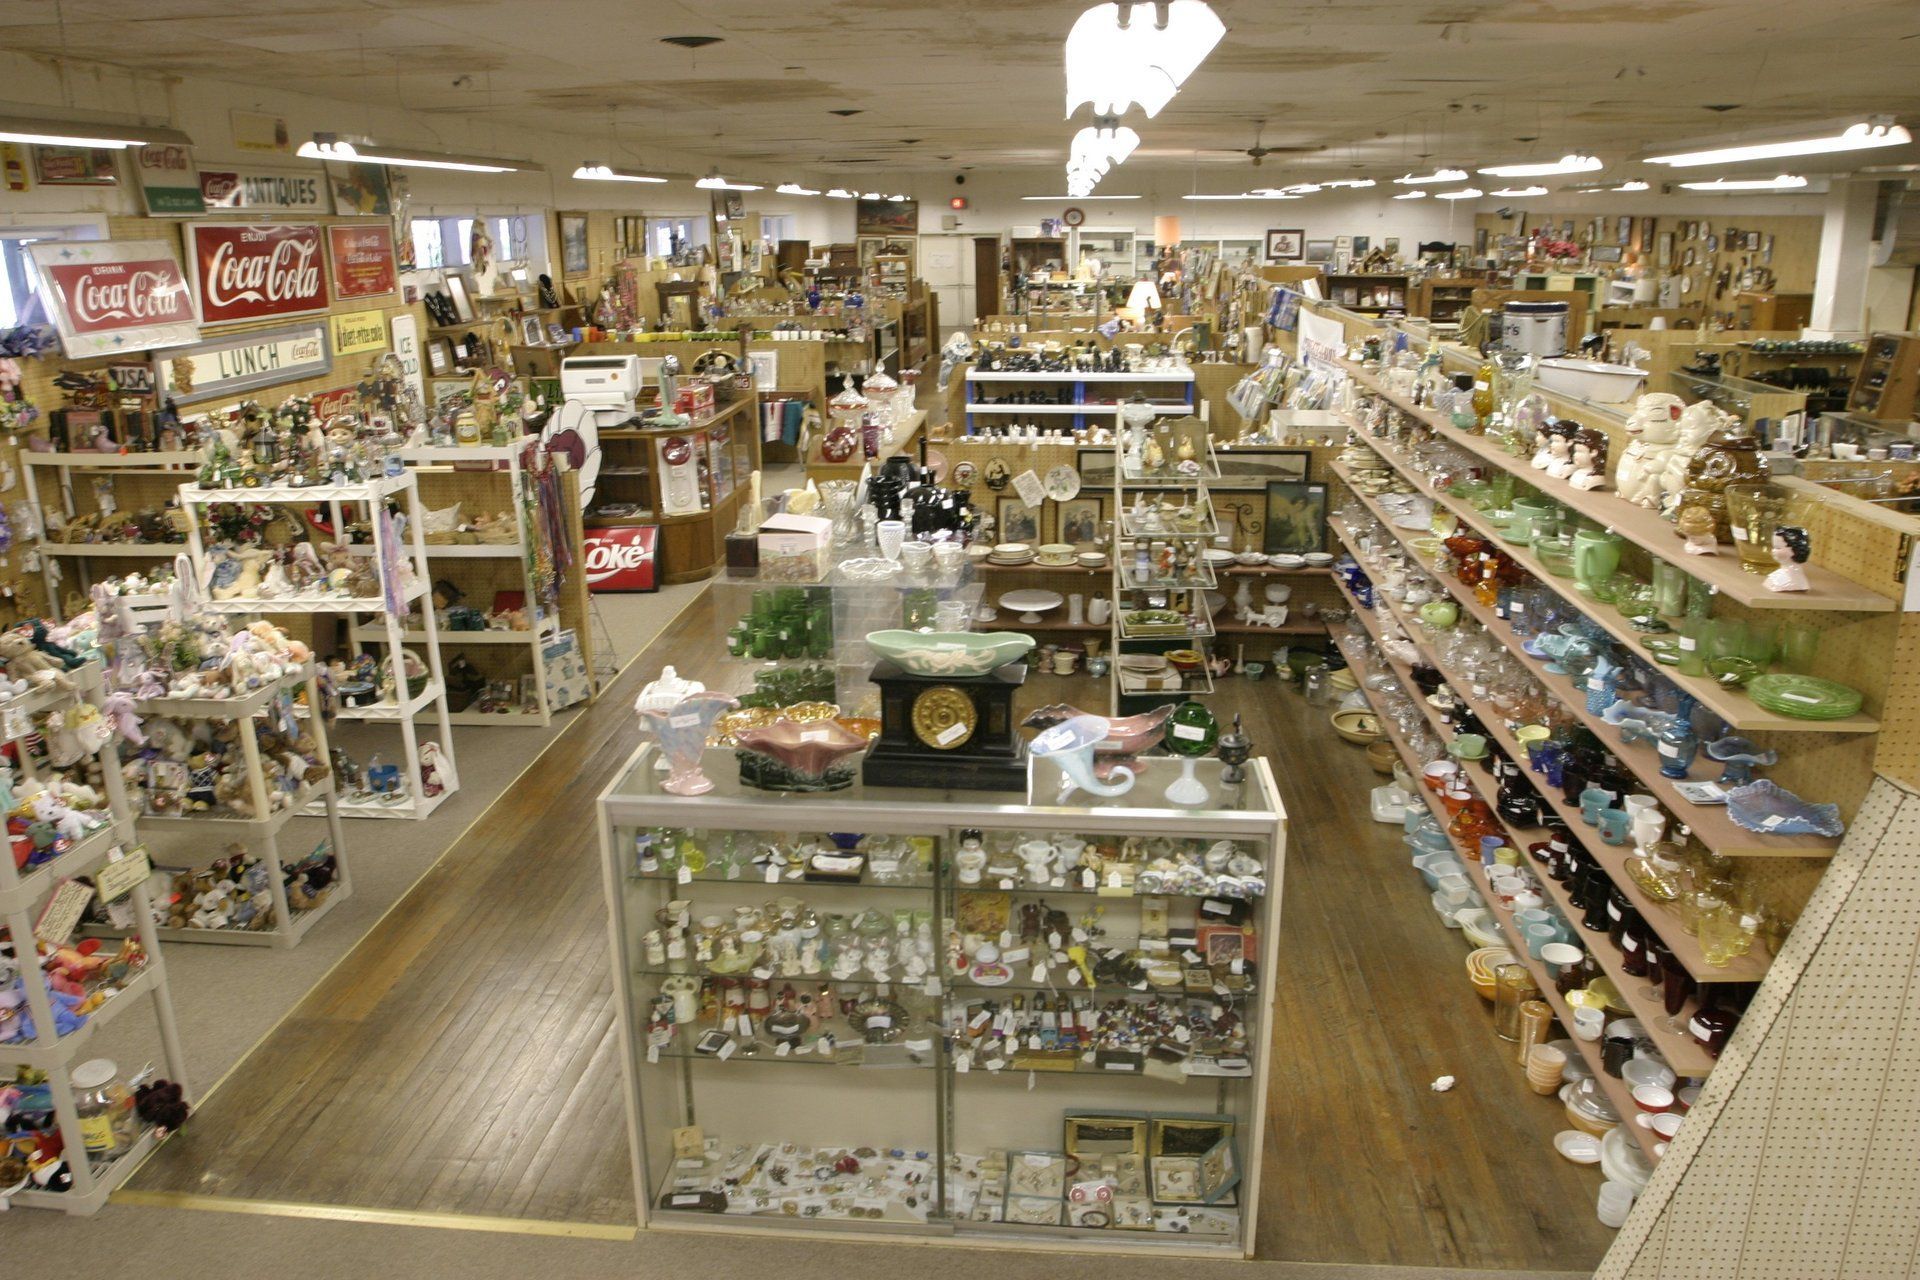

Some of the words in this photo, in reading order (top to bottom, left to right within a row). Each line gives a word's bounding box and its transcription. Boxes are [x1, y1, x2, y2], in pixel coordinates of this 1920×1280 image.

[245, 177, 318, 206] ANTIQUES
[240, 232, 267, 242] ENJOY
[92, 265, 126, 275] DRINK
[207, 238, 319, 307] Coca-Cola
[75, 269, 179, 323] Coca-Cola
[217, 342, 280, 379] LUNCH
